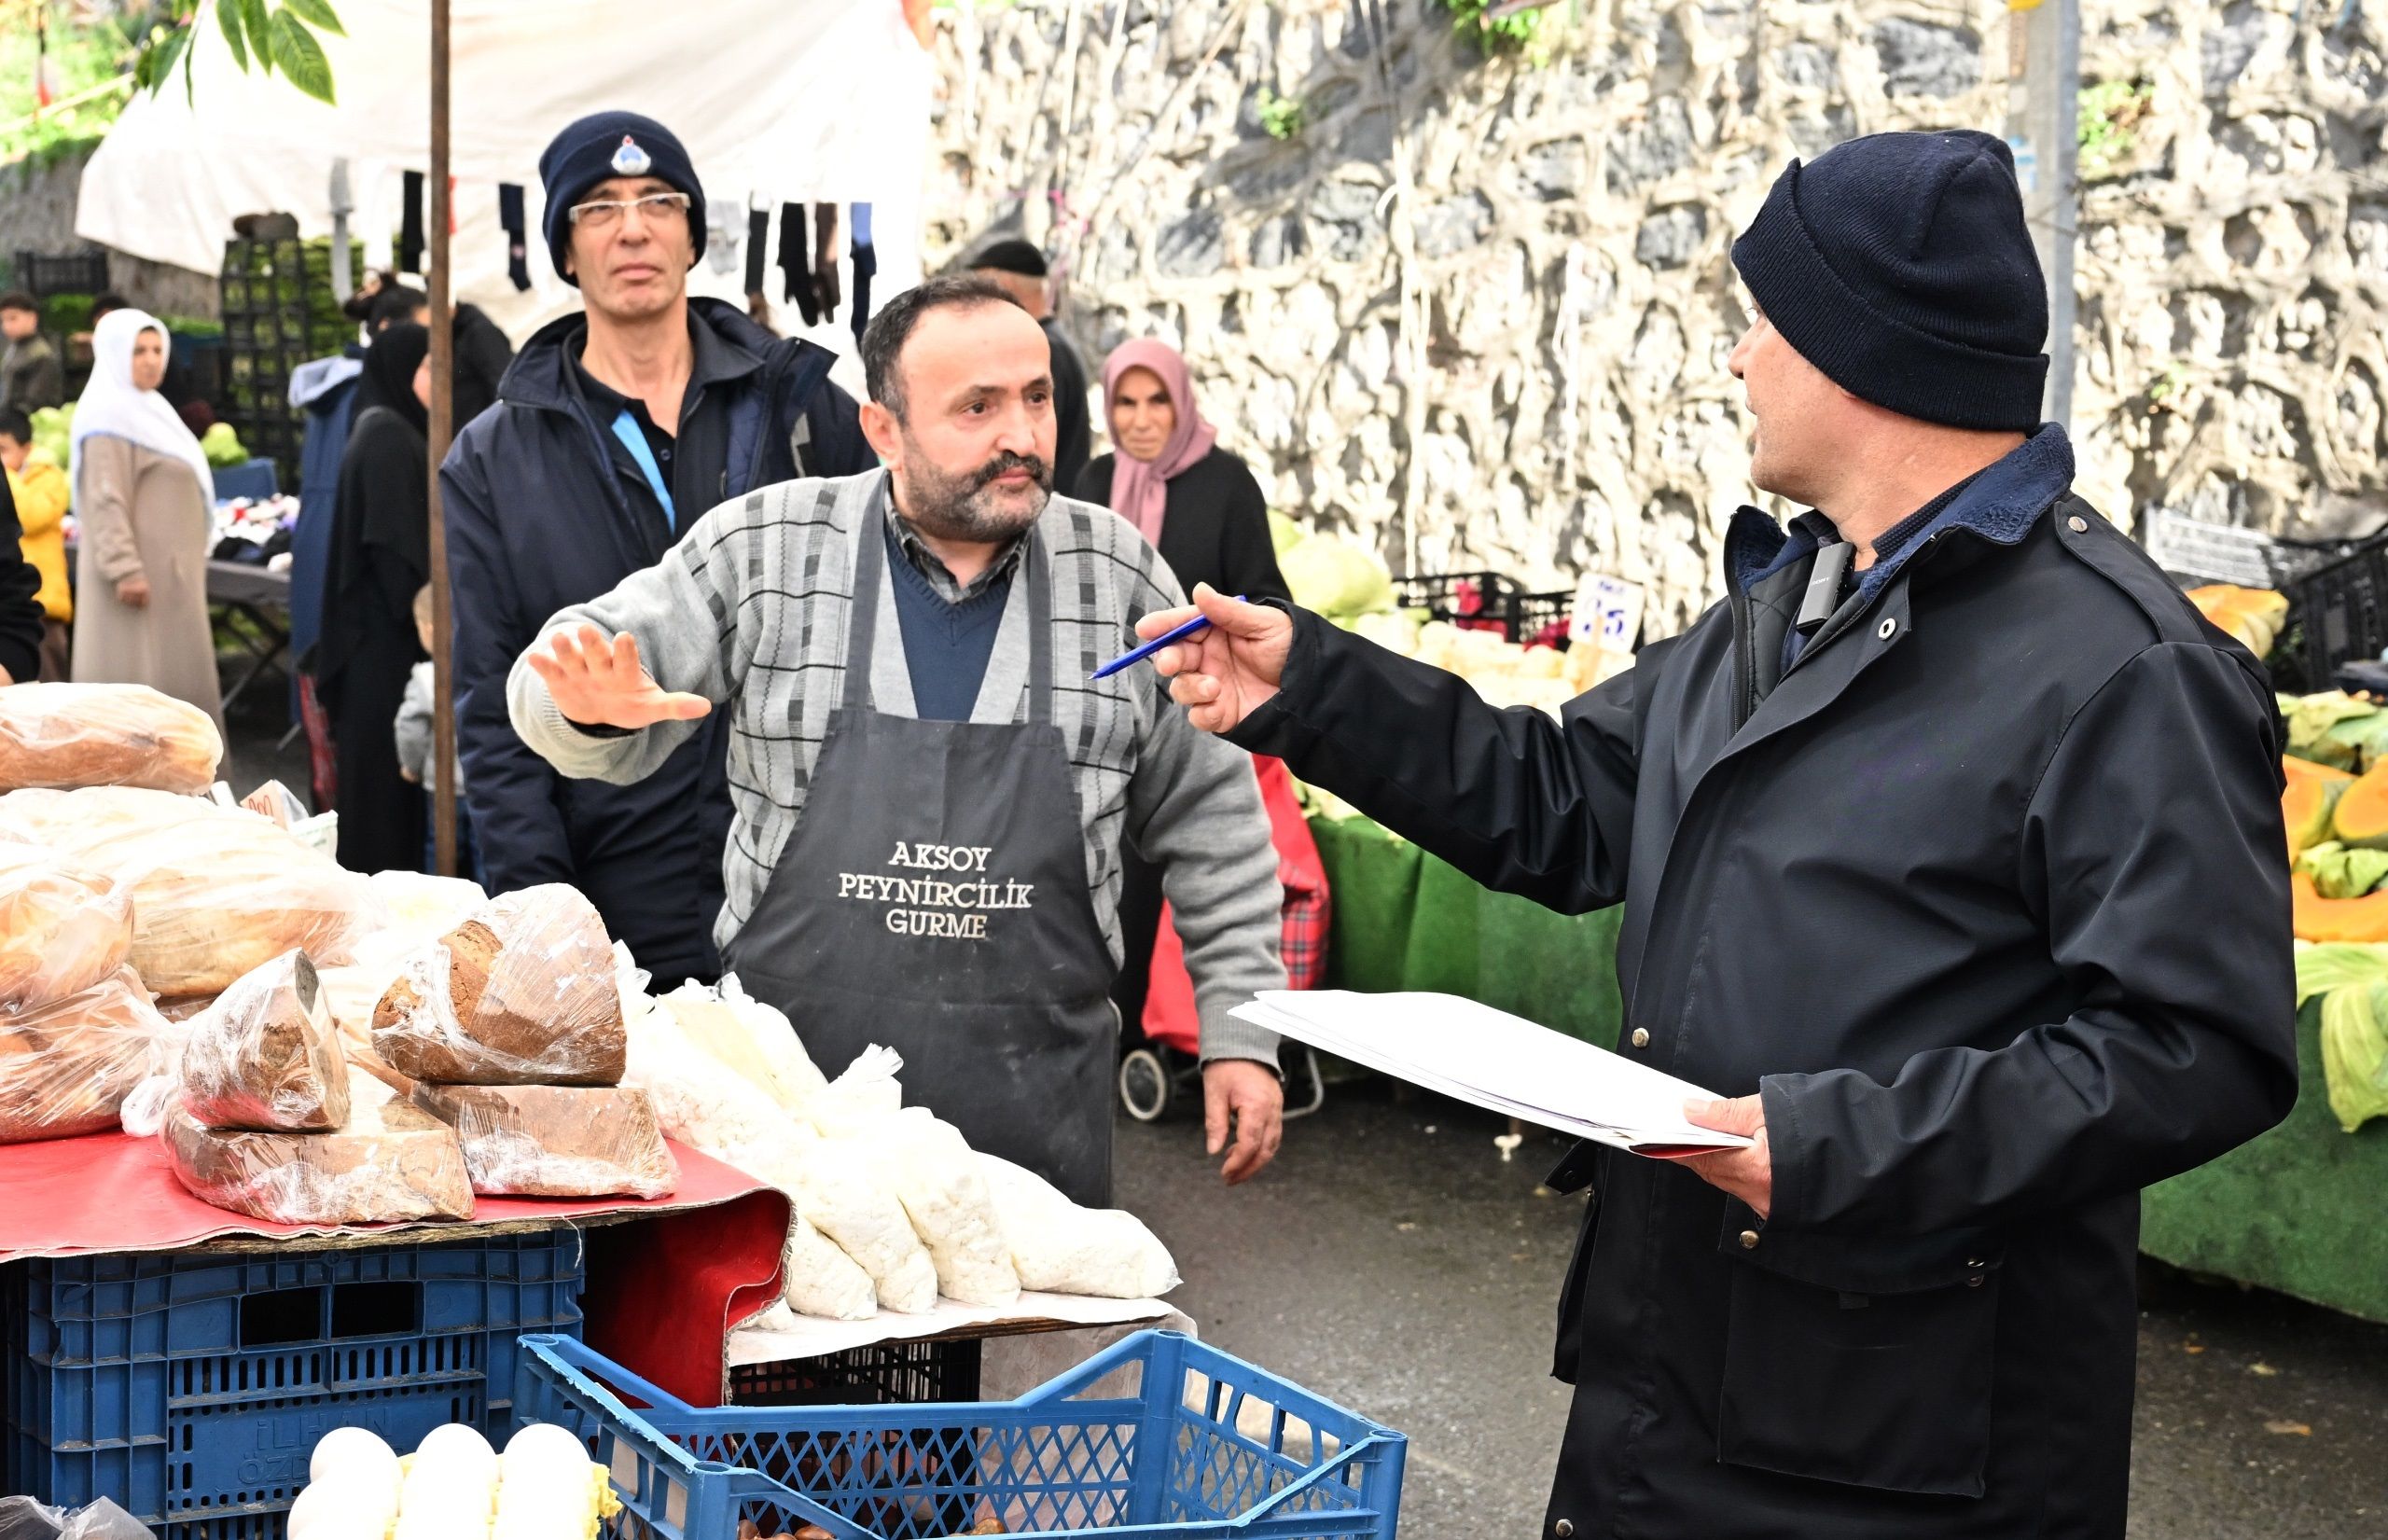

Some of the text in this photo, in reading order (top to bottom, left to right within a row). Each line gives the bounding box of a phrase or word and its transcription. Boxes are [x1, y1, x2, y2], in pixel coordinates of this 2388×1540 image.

[887, 841, 992, 871] AKSOY
[838, 873, 1034, 909] PEYNİRCİLİK
[886, 909, 988, 939] GURME
